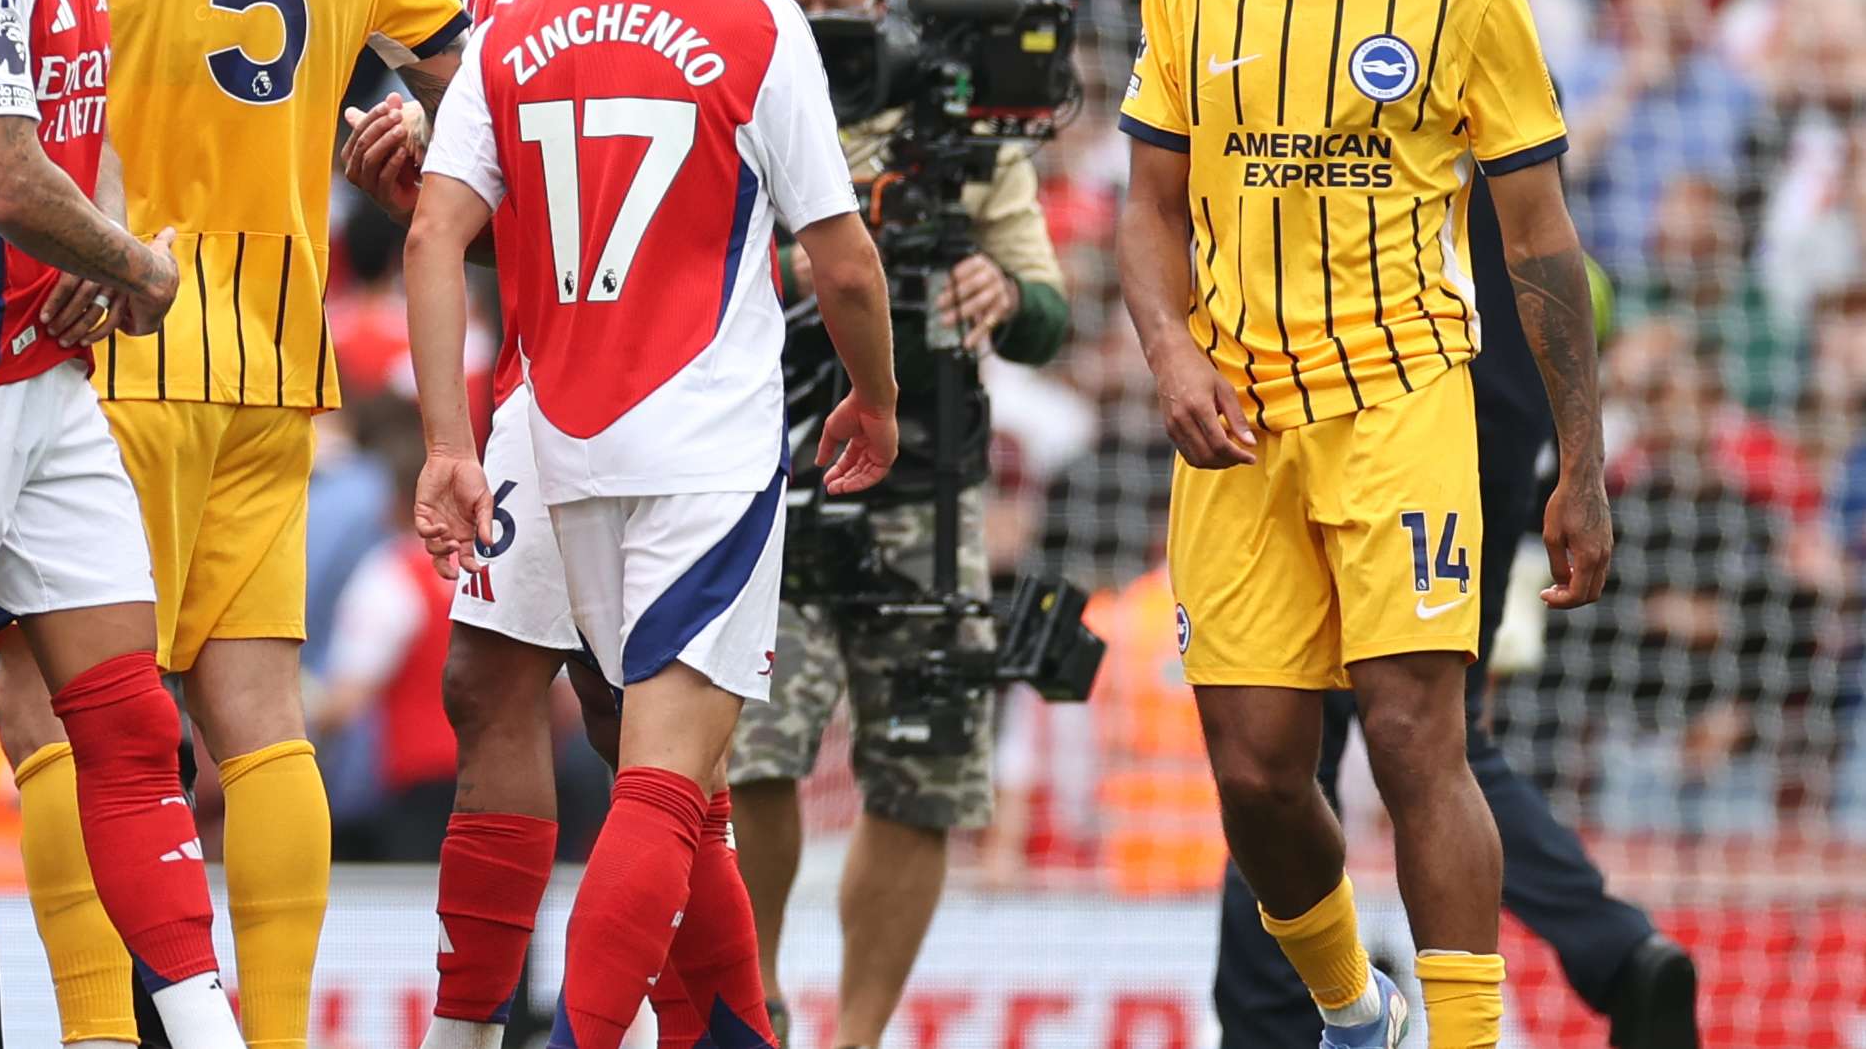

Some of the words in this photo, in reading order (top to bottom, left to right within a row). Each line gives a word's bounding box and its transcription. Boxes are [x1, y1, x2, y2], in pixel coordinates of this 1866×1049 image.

[503, 3, 726, 86] ZINCHENKO
[1223, 132, 1392, 158] AMERICAN
[1243, 163, 1394, 188] EXPRESS
[518, 98, 697, 303] 17
[1400, 510, 1471, 594] 14
